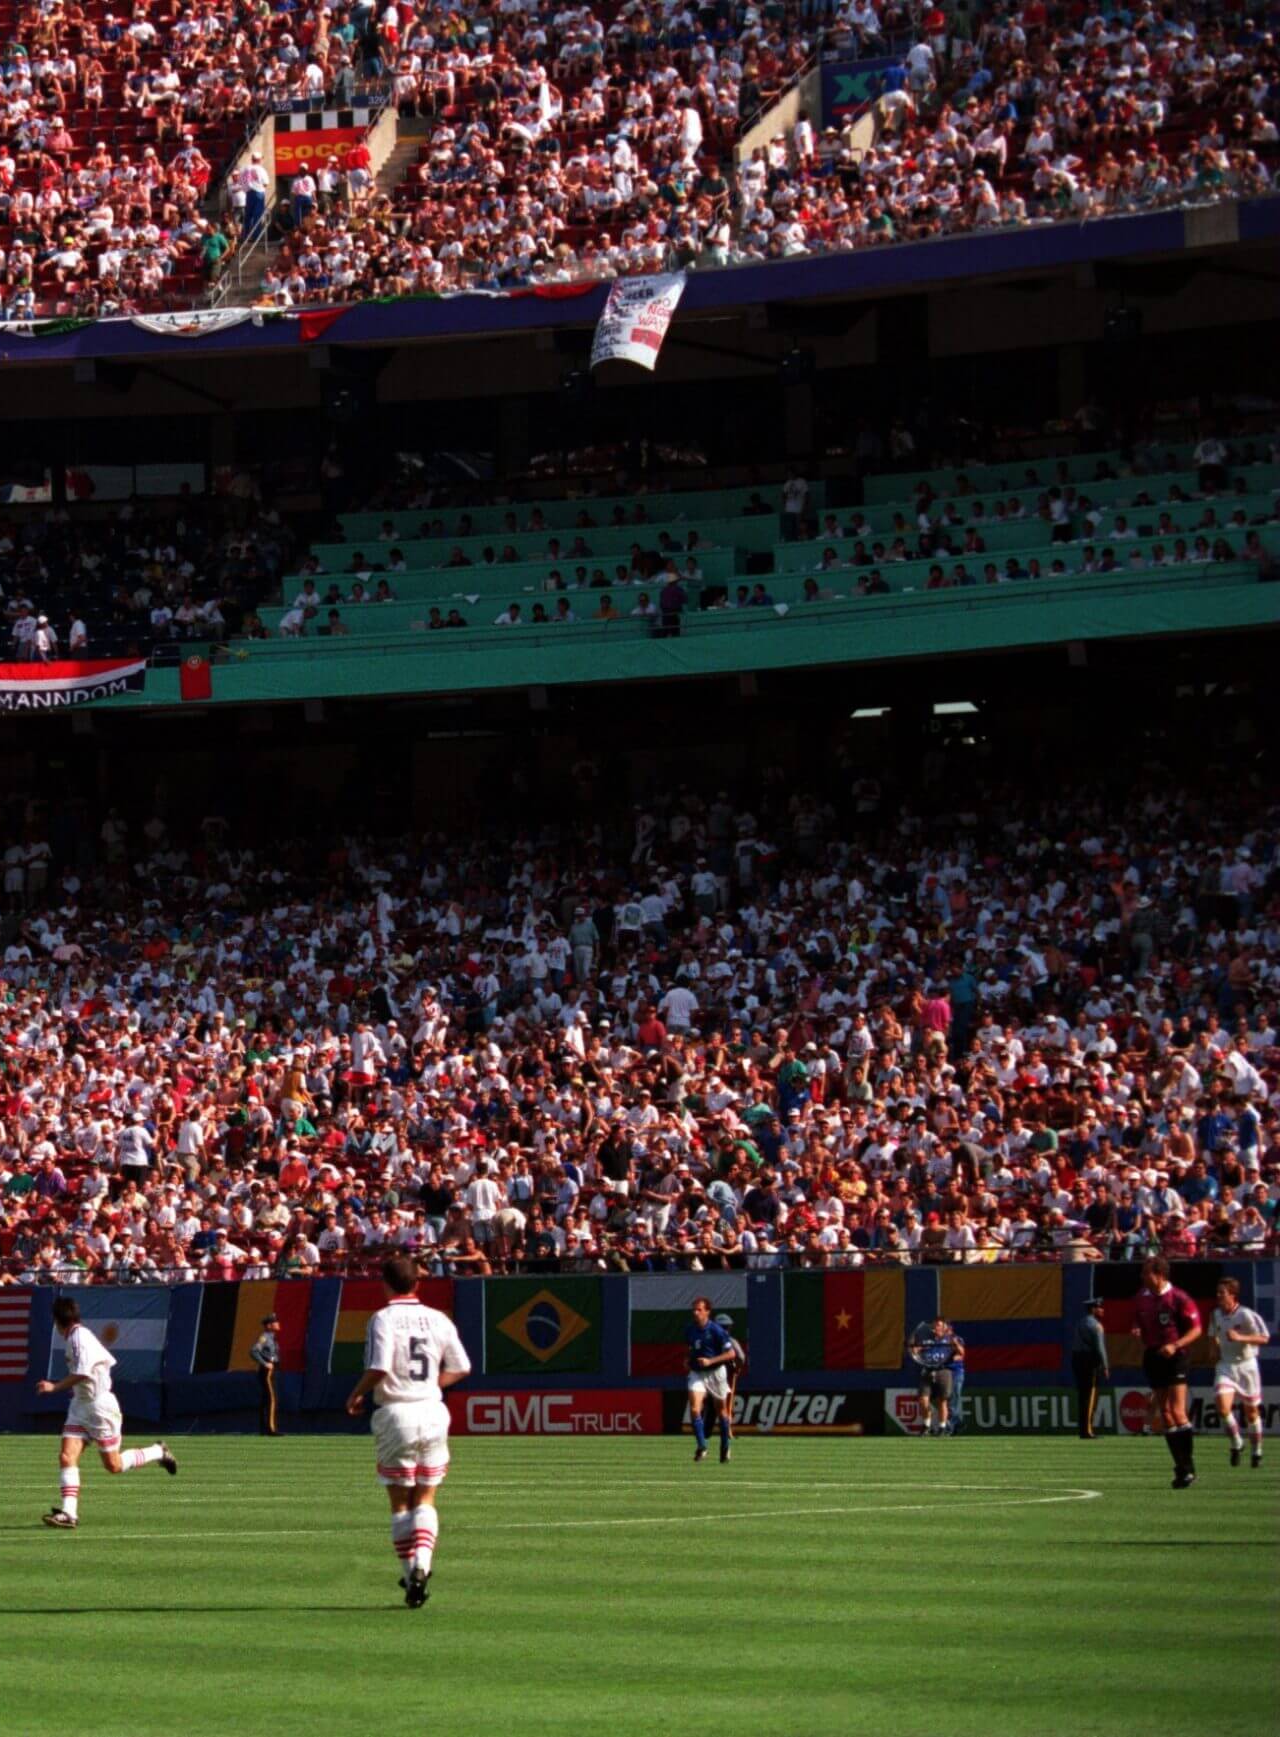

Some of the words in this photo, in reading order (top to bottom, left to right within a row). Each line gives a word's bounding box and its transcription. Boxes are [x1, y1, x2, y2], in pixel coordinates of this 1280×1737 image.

[409, 1336, 430, 1382] 5
[467, 1395, 573, 1432] GMC
[571, 1413, 643, 1432] TRUCK
[682, 1388, 846, 1432] ergizer
